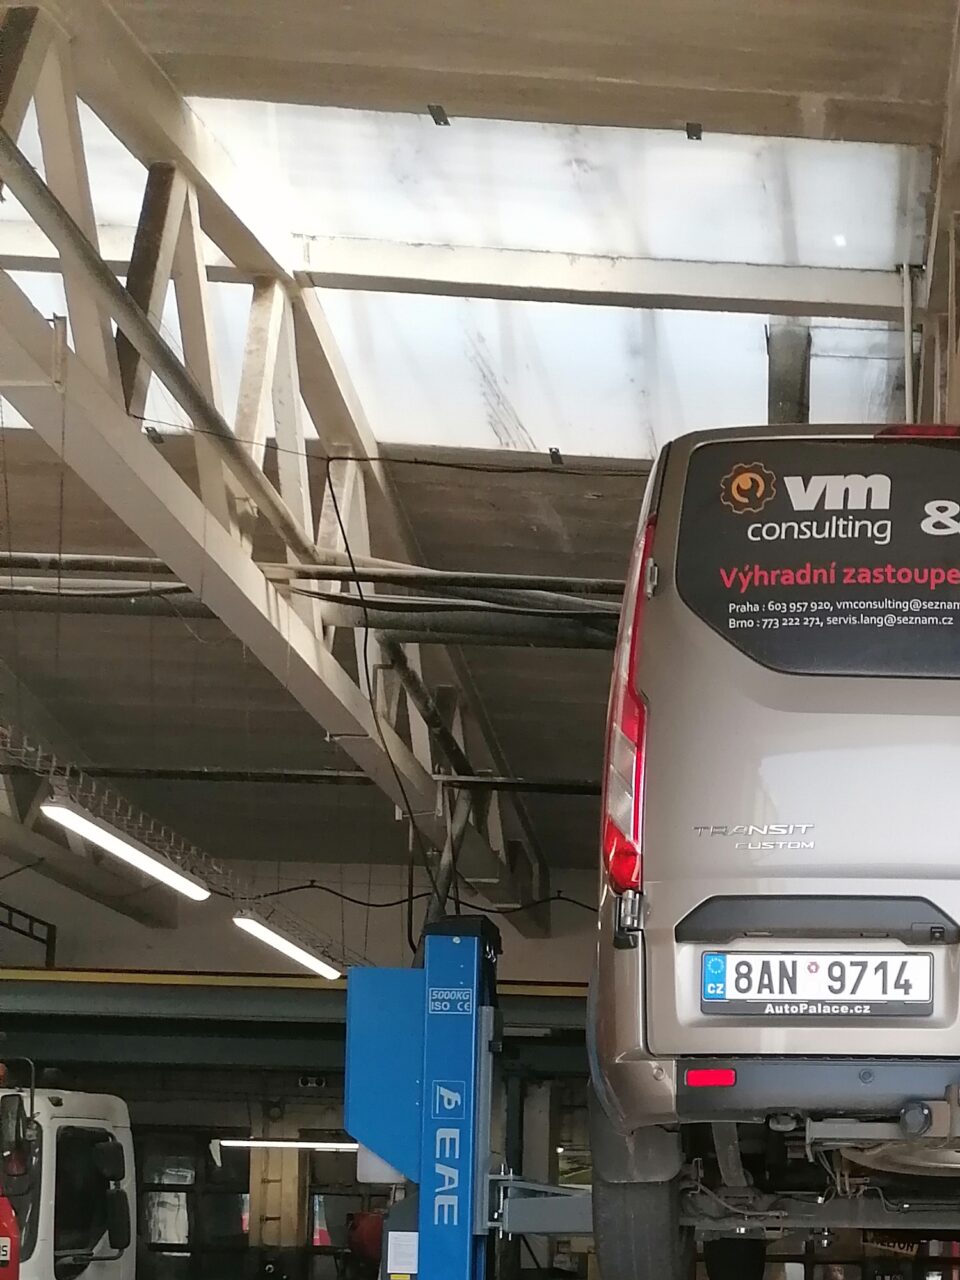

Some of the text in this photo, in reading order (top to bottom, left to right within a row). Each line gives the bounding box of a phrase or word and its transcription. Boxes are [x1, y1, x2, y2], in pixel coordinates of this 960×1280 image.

[783, 474, 892, 512] vm
[747, 516, 892, 545] consulting
[719, 561, 836, 593] Výhradní
[728, 602, 760, 613] Praha
[767, 601, 787, 613] 603
[789, 602, 808, 613] 957
[810, 601, 835, 613] 920,
[728, 617, 755, 629] Brno
[761, 618, 780, 629] 773
[781, 617, 801, 627] 222
[802, 617, 824, 628] 271,
[826, 613, 954, 628] servis.lang@seznam.cz
[693, 823, 815, 837] TRANSIT
[735, 840, 816, 850] CUSTOM
[734, 960, 913, 995] 8AN 9714
[431, 990, 471, 1000] 5000KG
[707, 983, 725, 994] CZ
[431, 1001, 451, 1011] ISO
[764, 1003, 871, 1014] AutoPalace.cz
[434, 1128, 460, 1227] EAE
